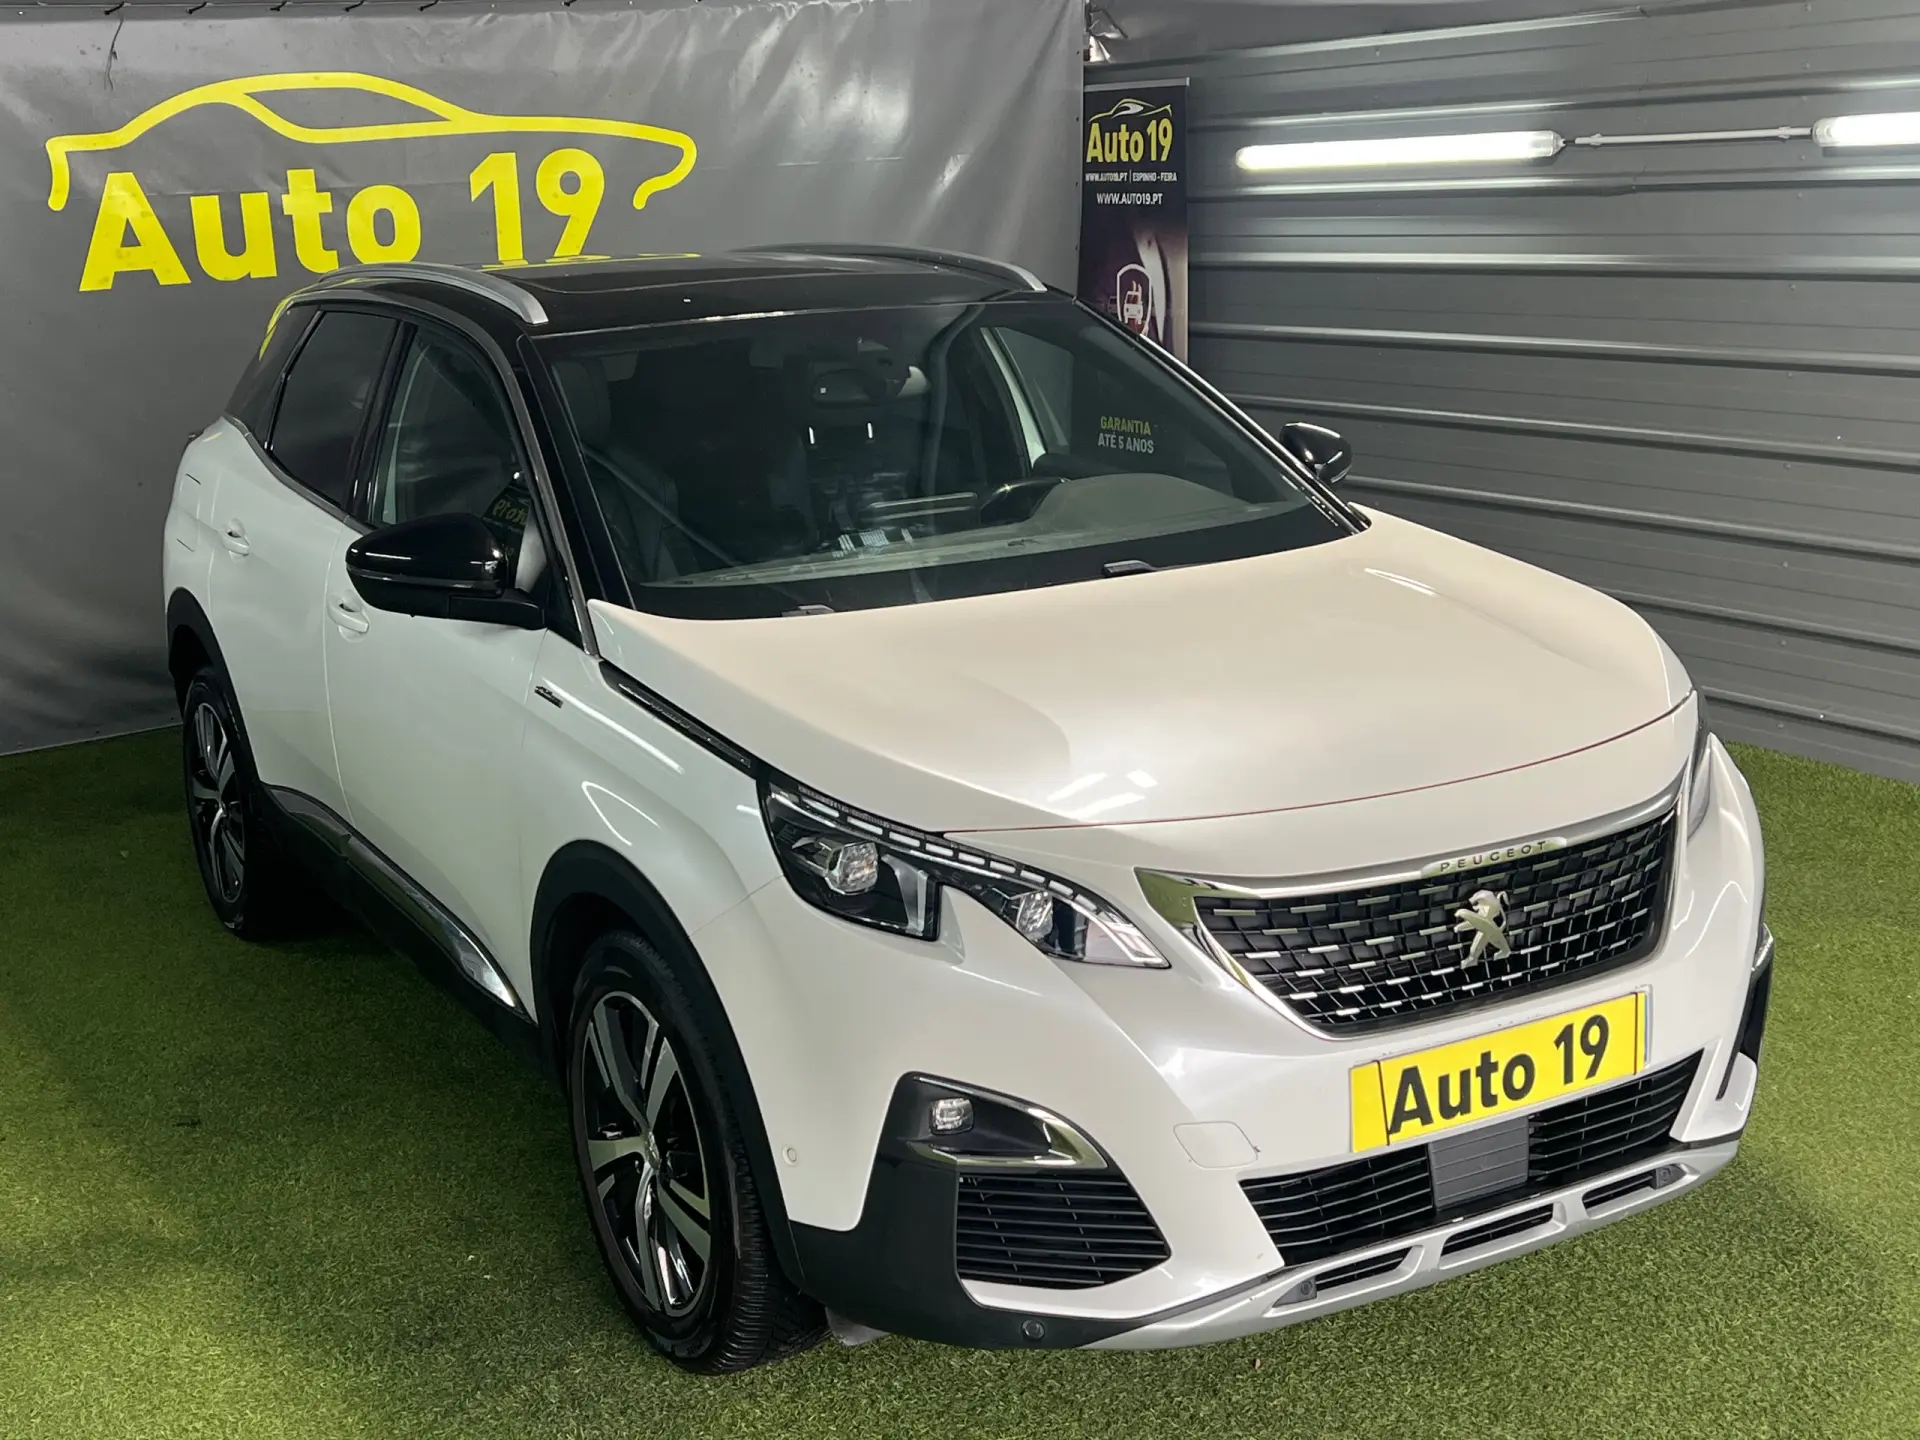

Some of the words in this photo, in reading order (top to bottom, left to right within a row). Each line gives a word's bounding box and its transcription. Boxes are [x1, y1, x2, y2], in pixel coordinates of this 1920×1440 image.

[1086, 122, 1144, 163] Auto
[1147, 117, 1173, 162] 19
[1096, 192, 1163, 205] WWW.AUTO19.PT
[79, 168, 421, 292] Auto
[470, 148, 605, 261] 19
[1100, 416, 1151, 436] GARANTIA
[1098, 431, 1117, 448] ATÉ
[1118, 435, 1124, 450] 5
[1125, 436, 1154, 454] ANOS
[1440, 840, 1546, 872] PEUGEOT
[1389, 1050, 1536, 1135] Auto
[1553, 1014, 1610, 1086] 19
